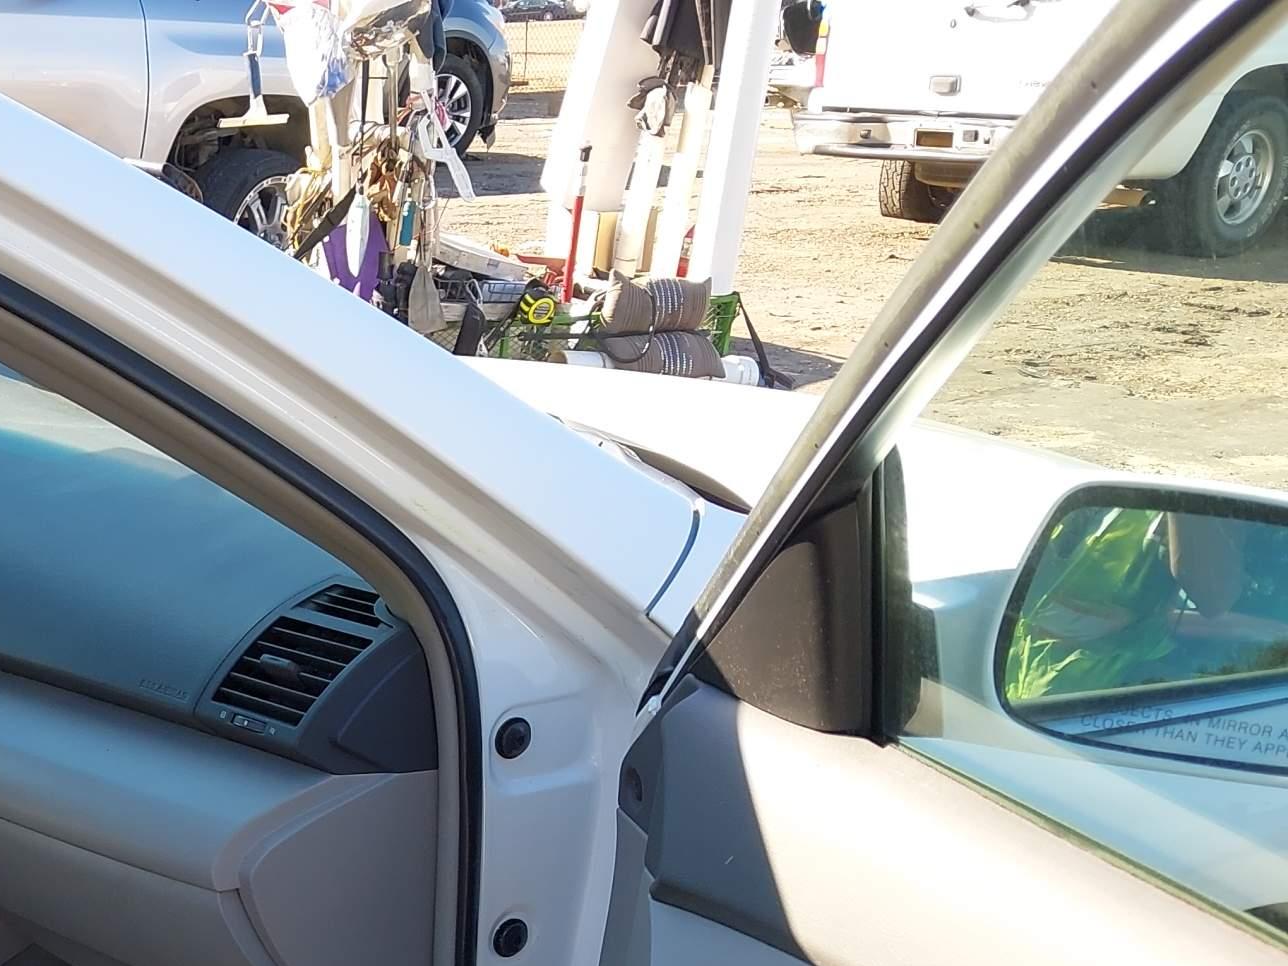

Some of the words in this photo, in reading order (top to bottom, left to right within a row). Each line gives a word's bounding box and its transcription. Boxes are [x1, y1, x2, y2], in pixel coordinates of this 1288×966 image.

[1080, 712, 1144, 735] CLOS
[1204, 732, 1249, 751] THEY
[1251, 740, 1288, 759] APP
[1207, 717, 1273, 737] MIRROR
